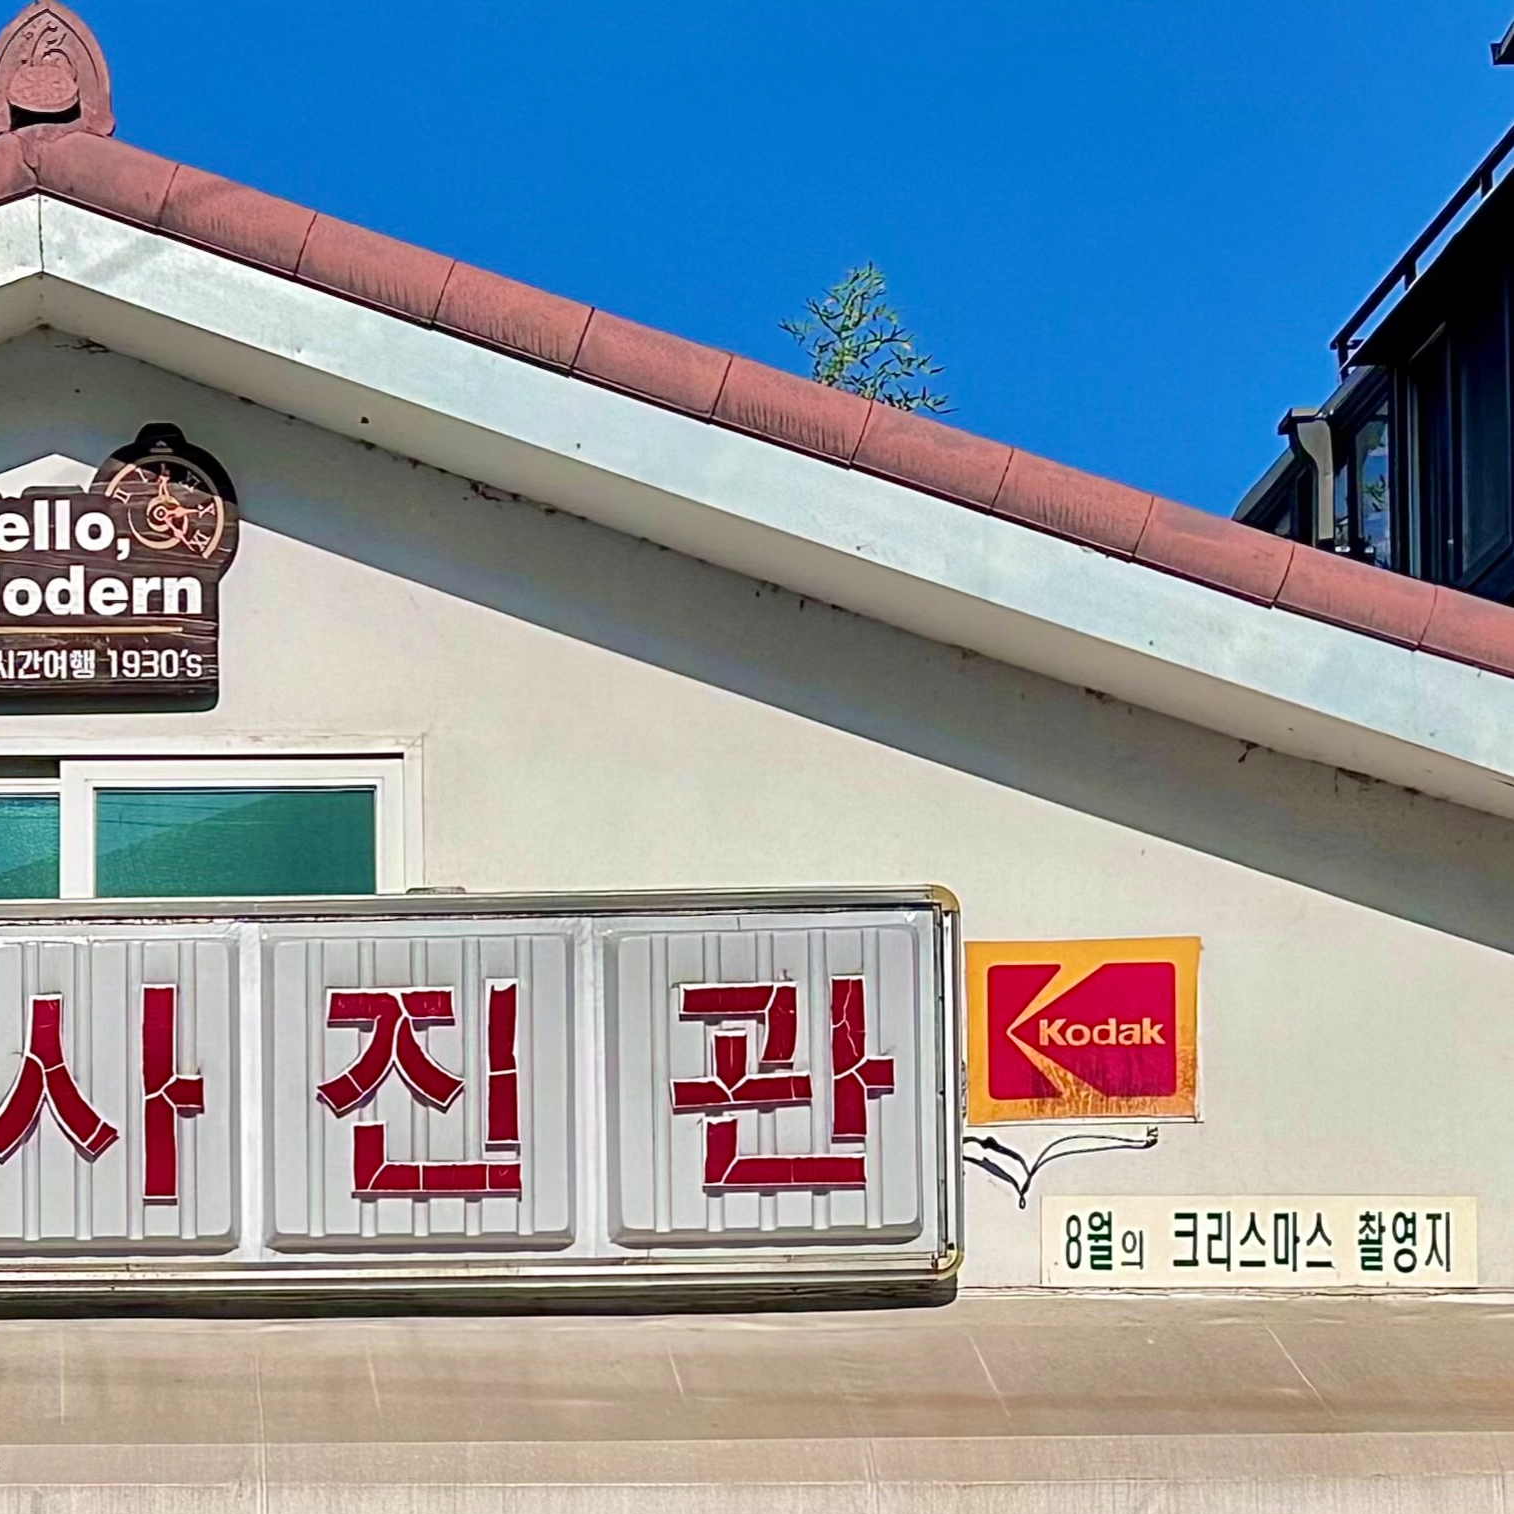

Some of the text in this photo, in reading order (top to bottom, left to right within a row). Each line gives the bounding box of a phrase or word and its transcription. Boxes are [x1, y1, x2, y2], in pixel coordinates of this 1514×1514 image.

[108, 649, 203, 679] 1930's
[1039, 1016, 1166, 1047] Kodak
[1065, 1210, 1452, 1273] 8월의 크리스마스 촬영지
